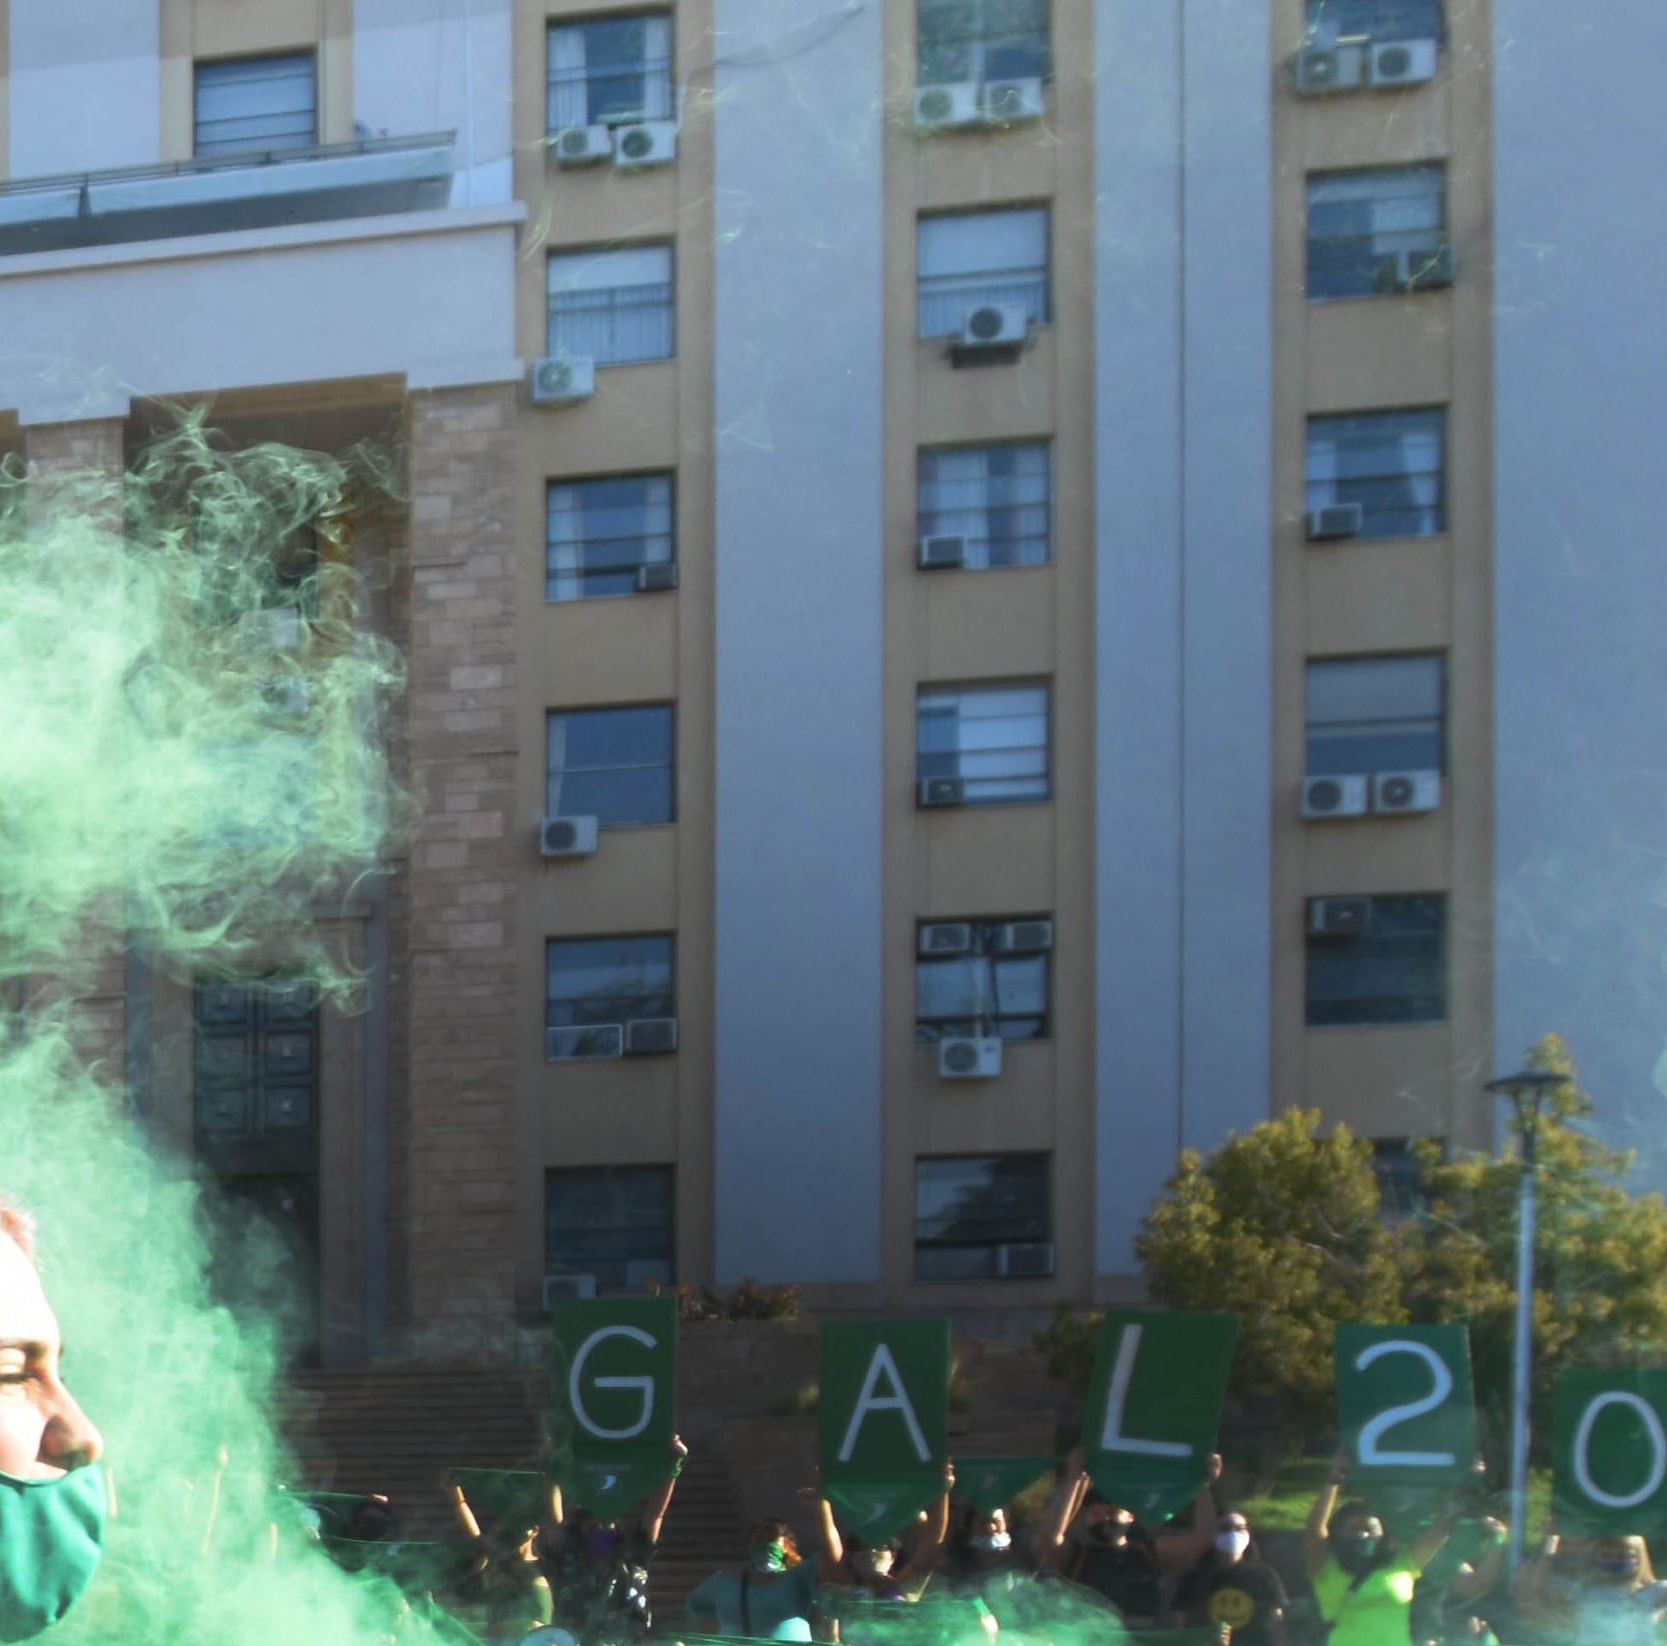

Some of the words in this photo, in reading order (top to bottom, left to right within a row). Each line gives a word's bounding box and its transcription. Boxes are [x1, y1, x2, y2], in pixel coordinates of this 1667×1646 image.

[567, 1325, 658, 1439] G
[838, 1343, 932, 1462] A
[1100, 1324, 1193, 1458] L
[1354, 1339, 1456, 1467] 2
